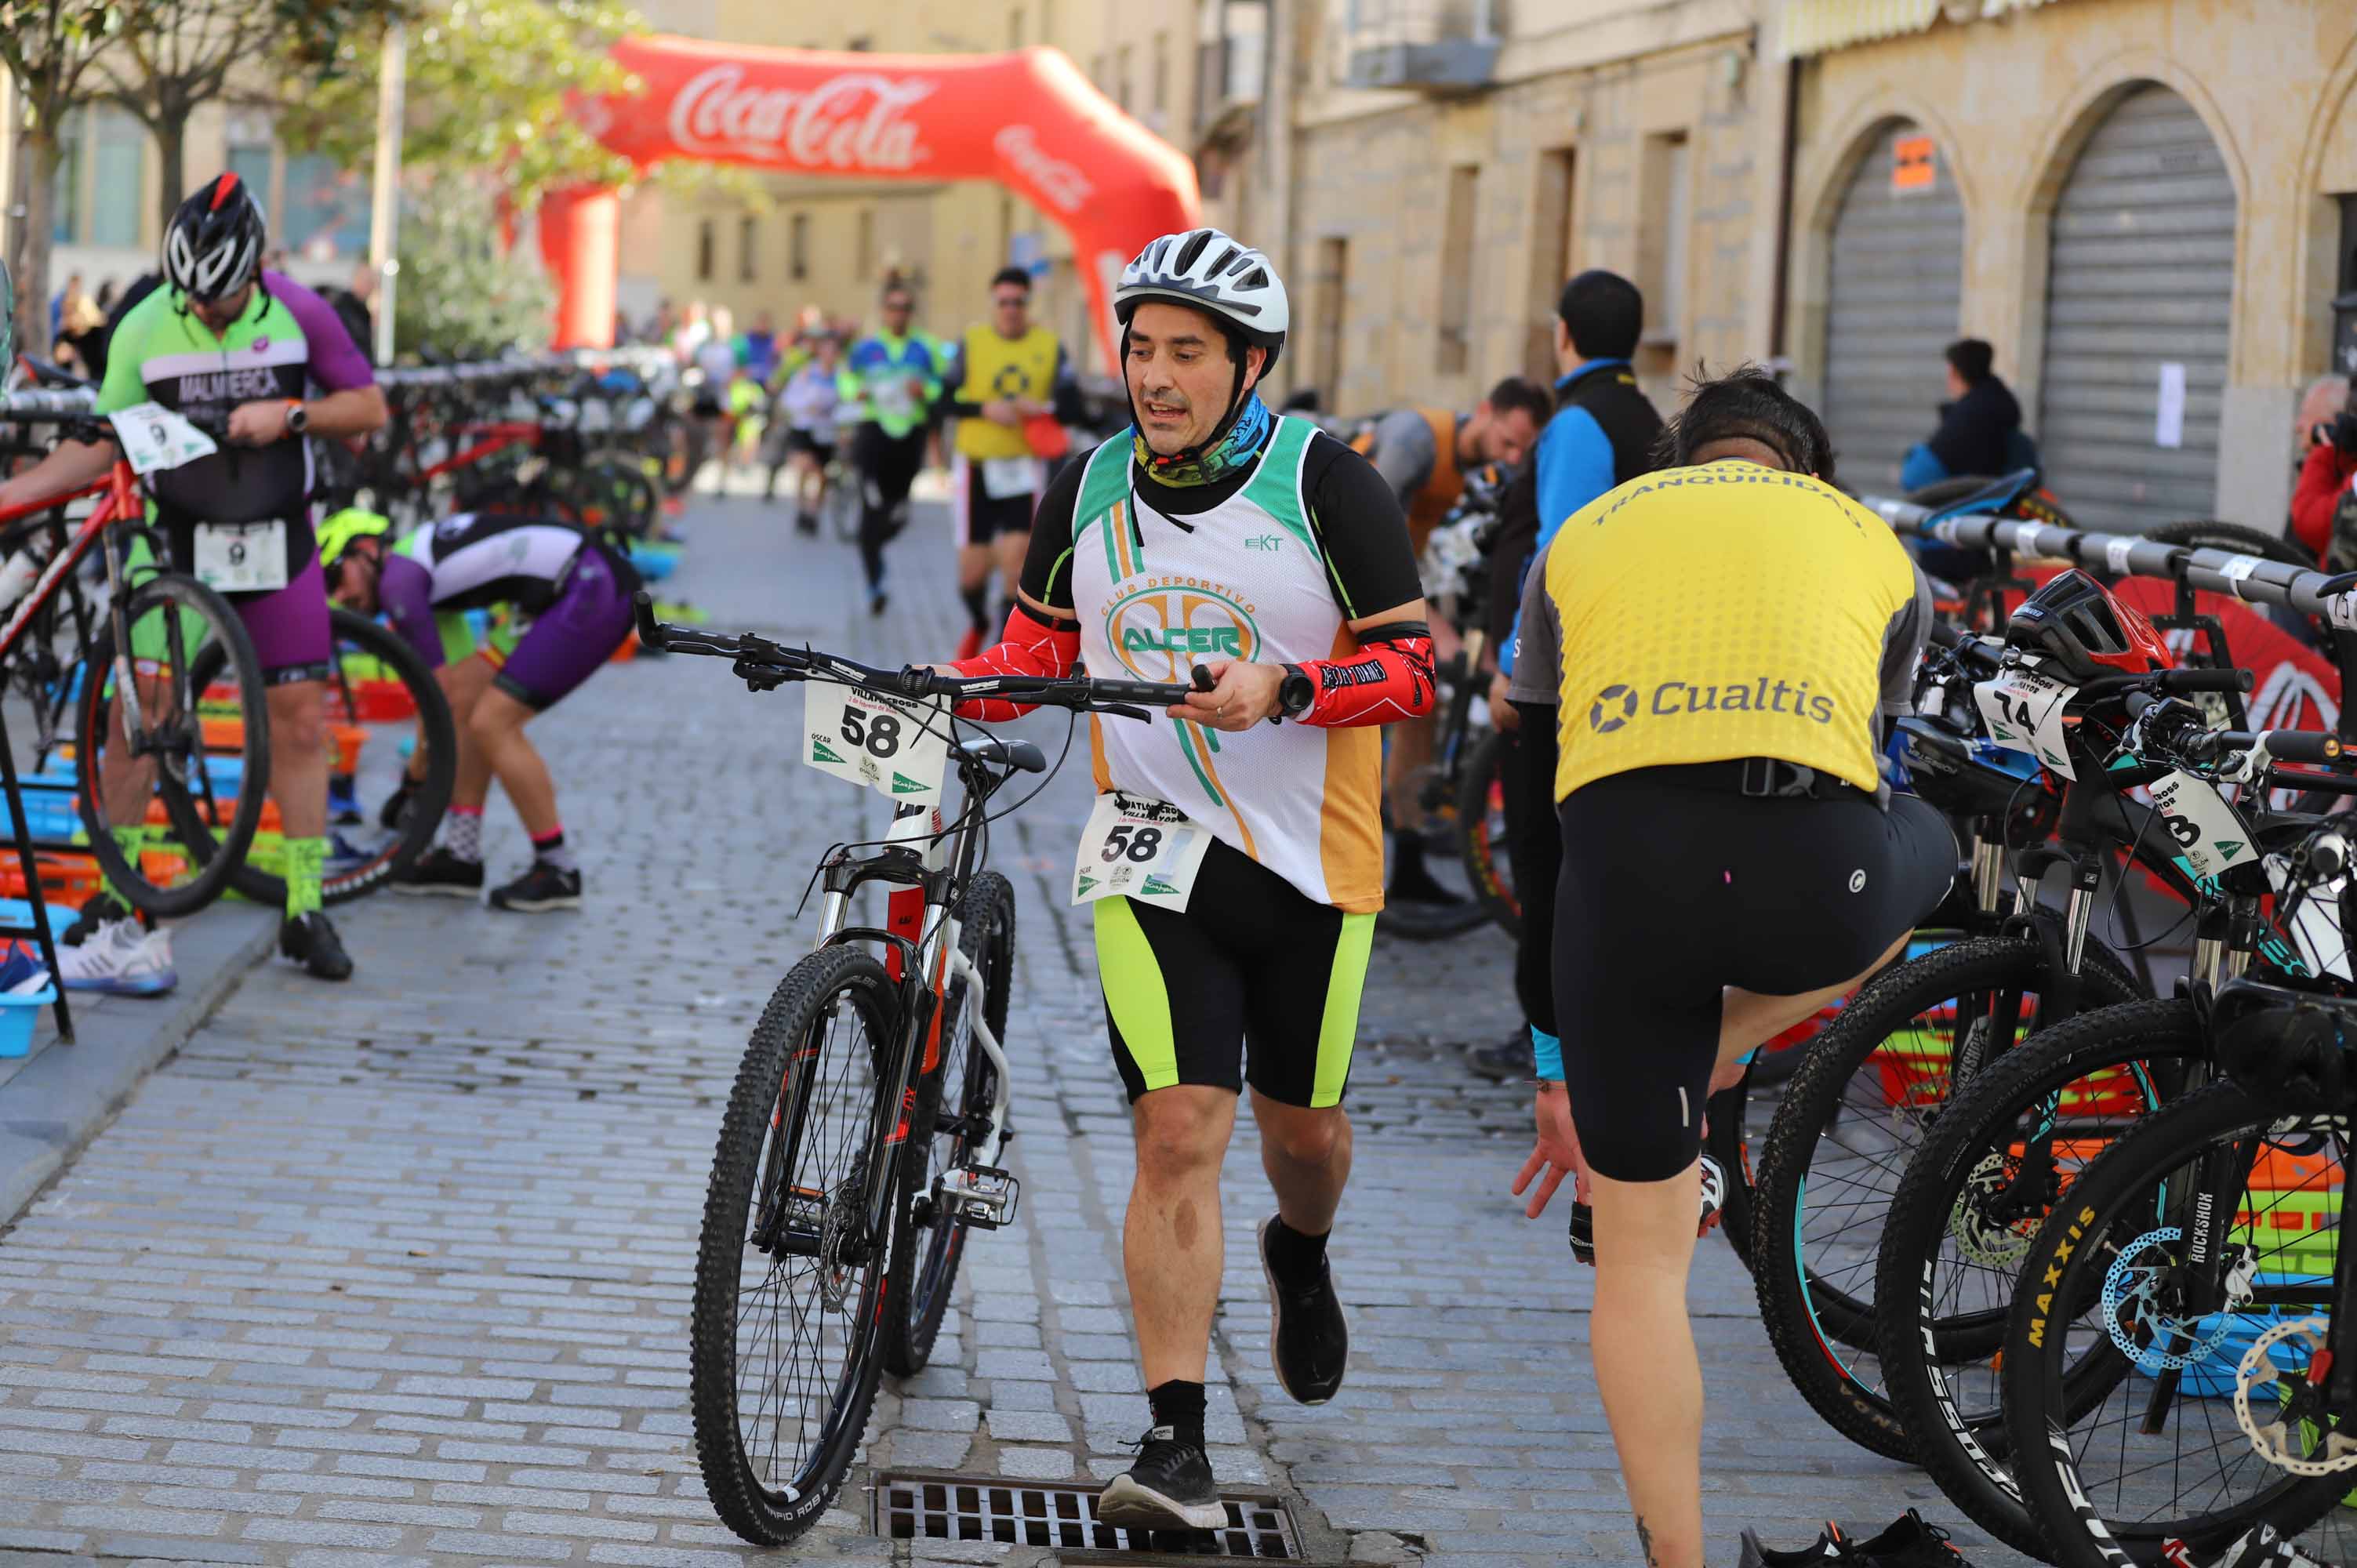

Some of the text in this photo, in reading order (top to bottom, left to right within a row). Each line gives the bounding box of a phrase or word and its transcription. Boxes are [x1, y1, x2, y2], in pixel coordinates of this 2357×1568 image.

[229, 541, 245, 567] 9
[1244, 534, 1284, 551] EKT
[1100, 575, 1256, 617] CLUB DEPORTIVO
[1122, 626, 1243, 657] ALCER
[1651, 677, 1835, 724] Cualtis
[1993, 690, 2036, 737] 74
[841, 704, 901, 758] 58
[1101, 826, 1162, 862] 58
[2191, 1192, 2214, 1264] ROCKSHOX
[2028, 1205, 2096, 1349] MAXXIS
